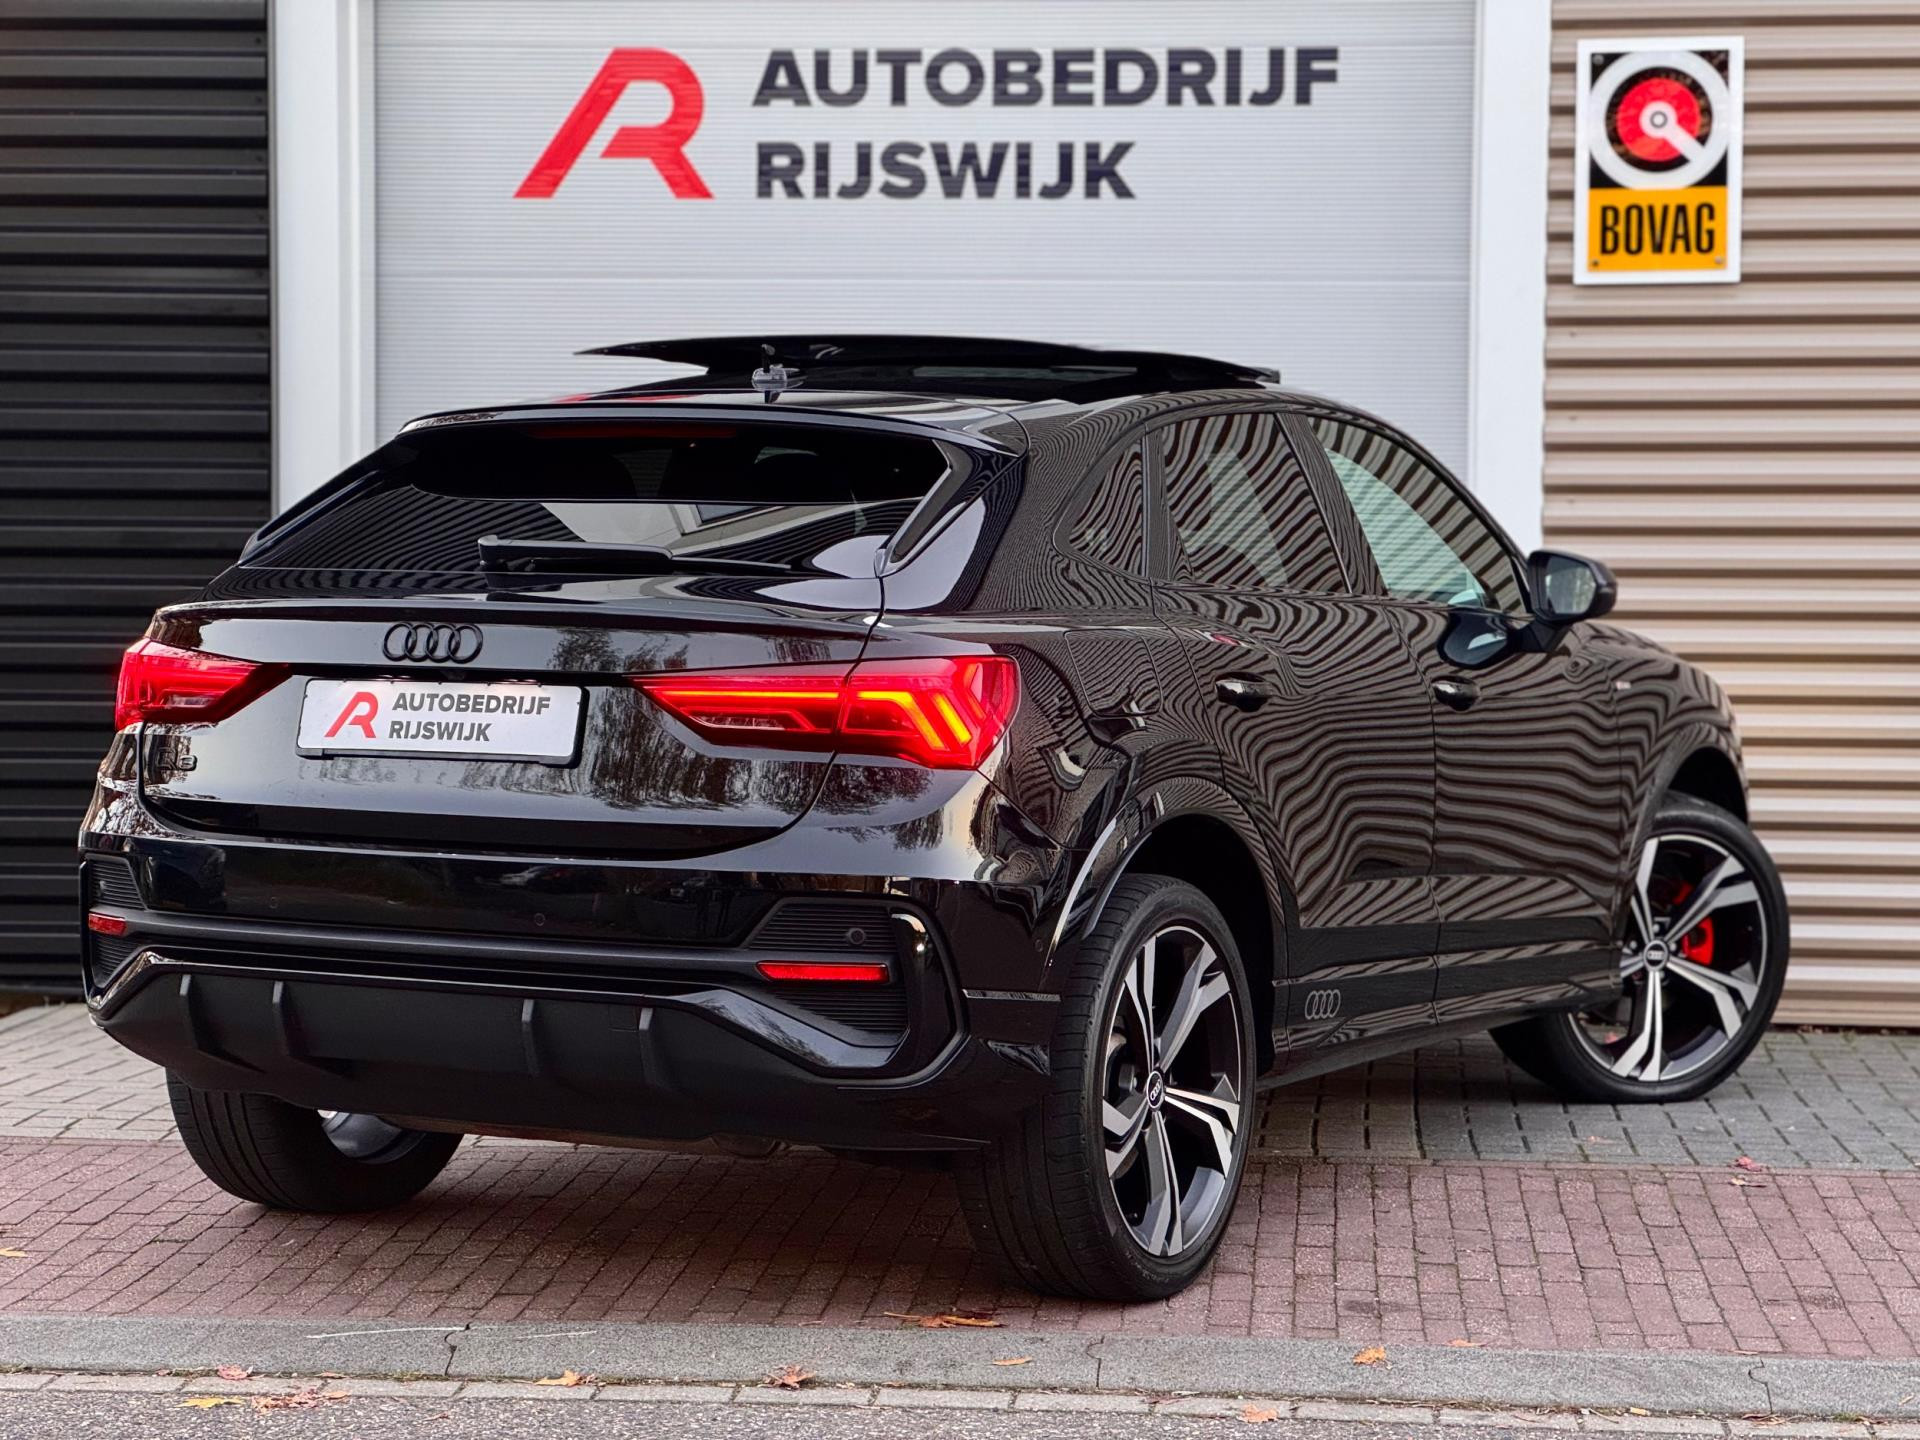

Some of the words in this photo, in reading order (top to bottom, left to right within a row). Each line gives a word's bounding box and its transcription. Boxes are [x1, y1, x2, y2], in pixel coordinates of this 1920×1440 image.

[752, 47, 1339, 108] AUTOBEDRIJF
[756, 141, 1137, 200] RIJSWIJK
[1600, 202, 1716, 255] BOVAG
[392, 692, 551, 715] AUTOBEDRIJF
[388, 720, 492, 742] RIJSWIJK
